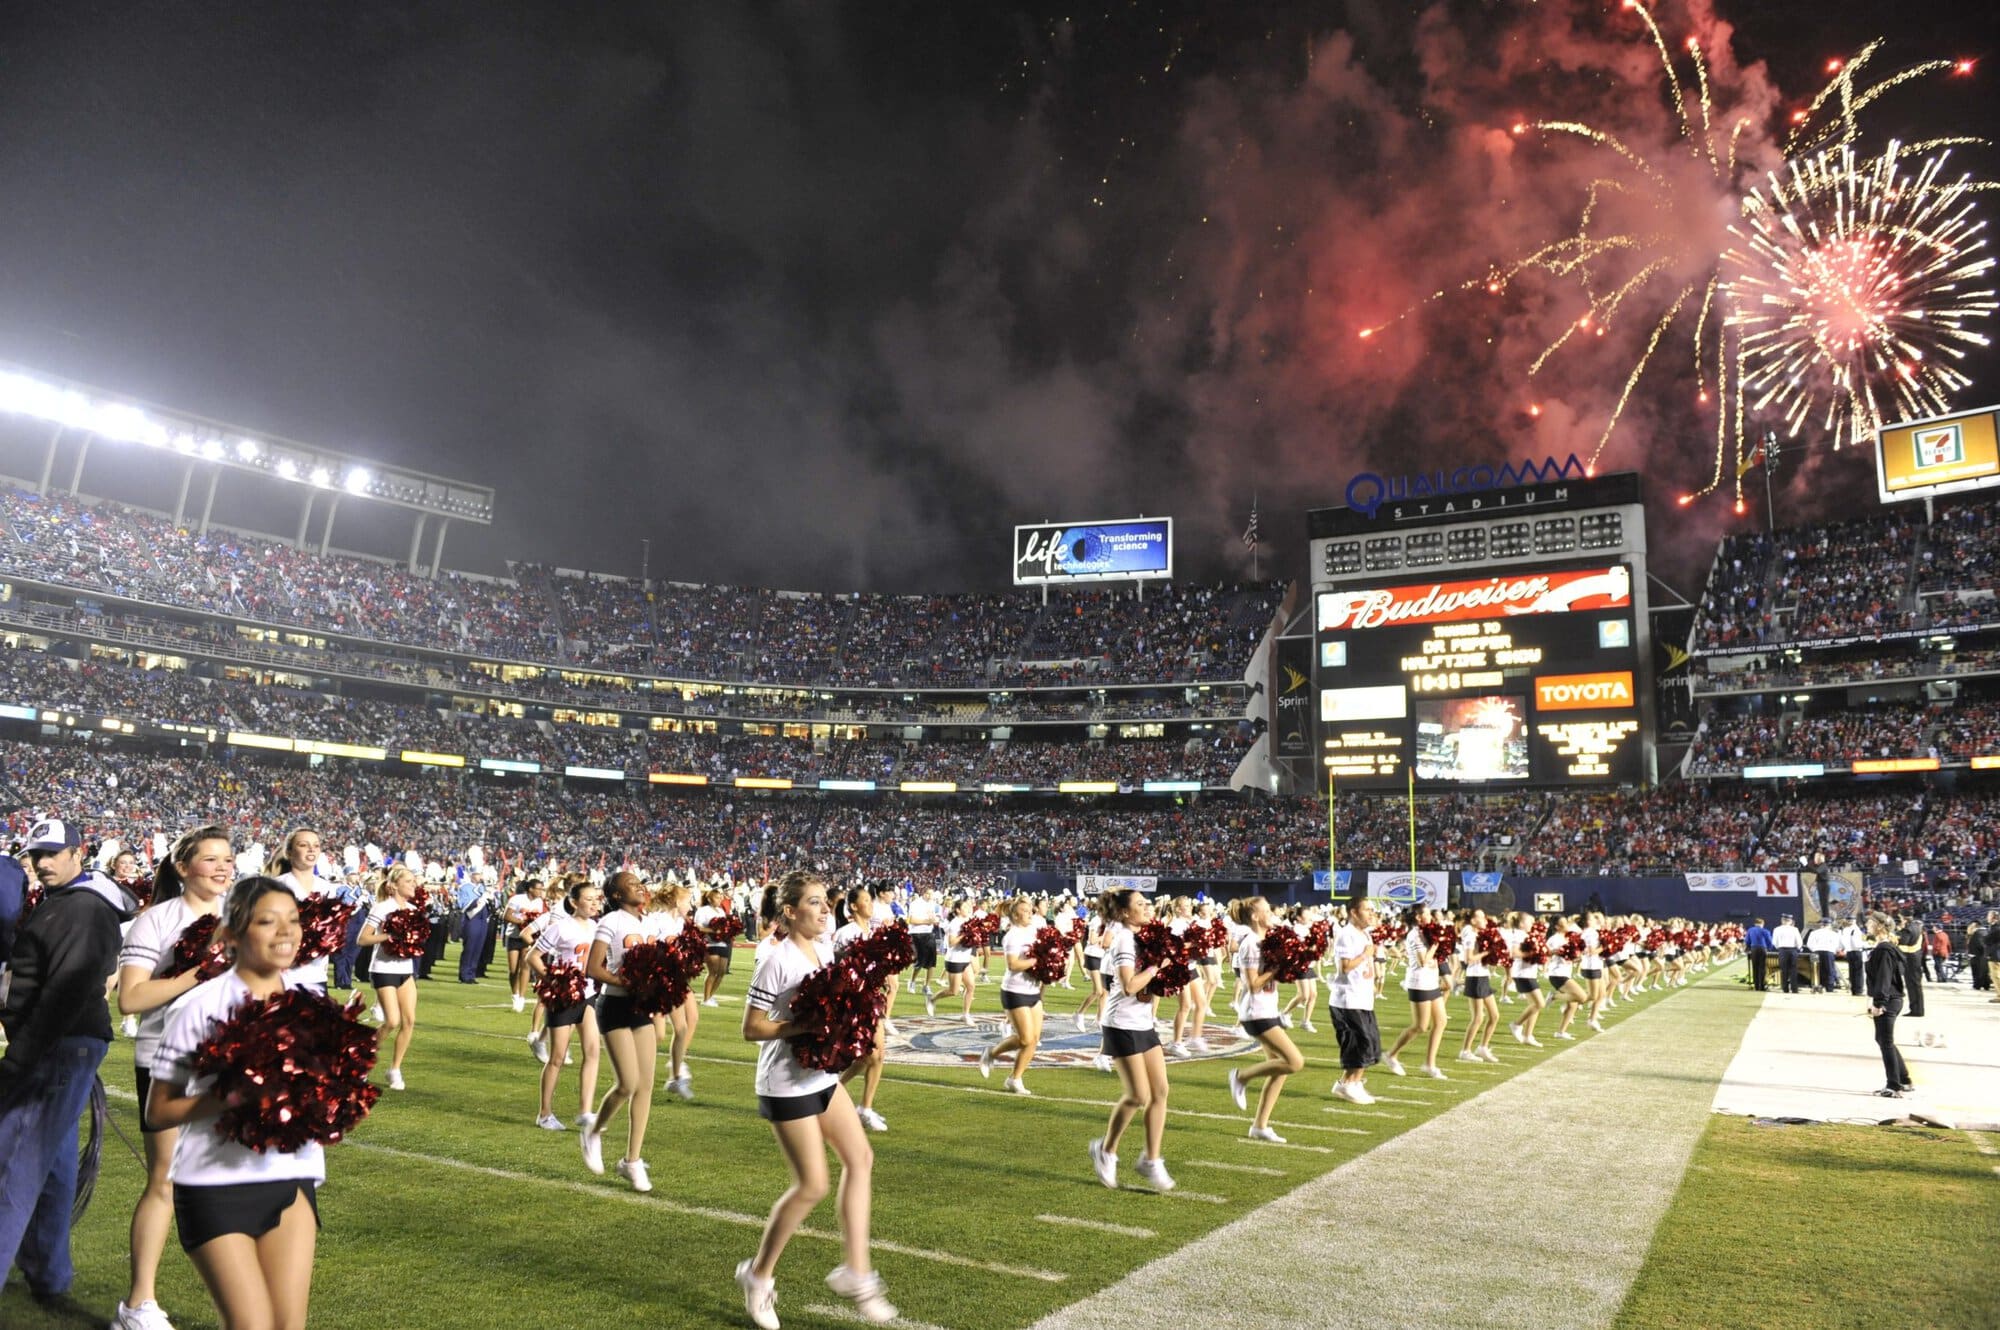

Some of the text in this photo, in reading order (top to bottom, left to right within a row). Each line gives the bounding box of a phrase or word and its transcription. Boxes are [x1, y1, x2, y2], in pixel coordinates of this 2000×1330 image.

[1346, 454, 1586, 520] QUALCOMM
[1394, 488, 1568, 518] STADIUM
[1099, 532, 1162, 543] Transforming
[1113, 542, 1148, 551] science
[1018, 530, 1068, 574] life
[1053, 560, 1110, 570] technologies
[1351, 577, 1550, 629] Budweiser
[1656, 675, 1690, 688] Sprin
[1278, 696, 1309, 709] Sprint
[1540, 682, 1628, 703] TOYOTA
[1764, 875, 1789, 895] N
